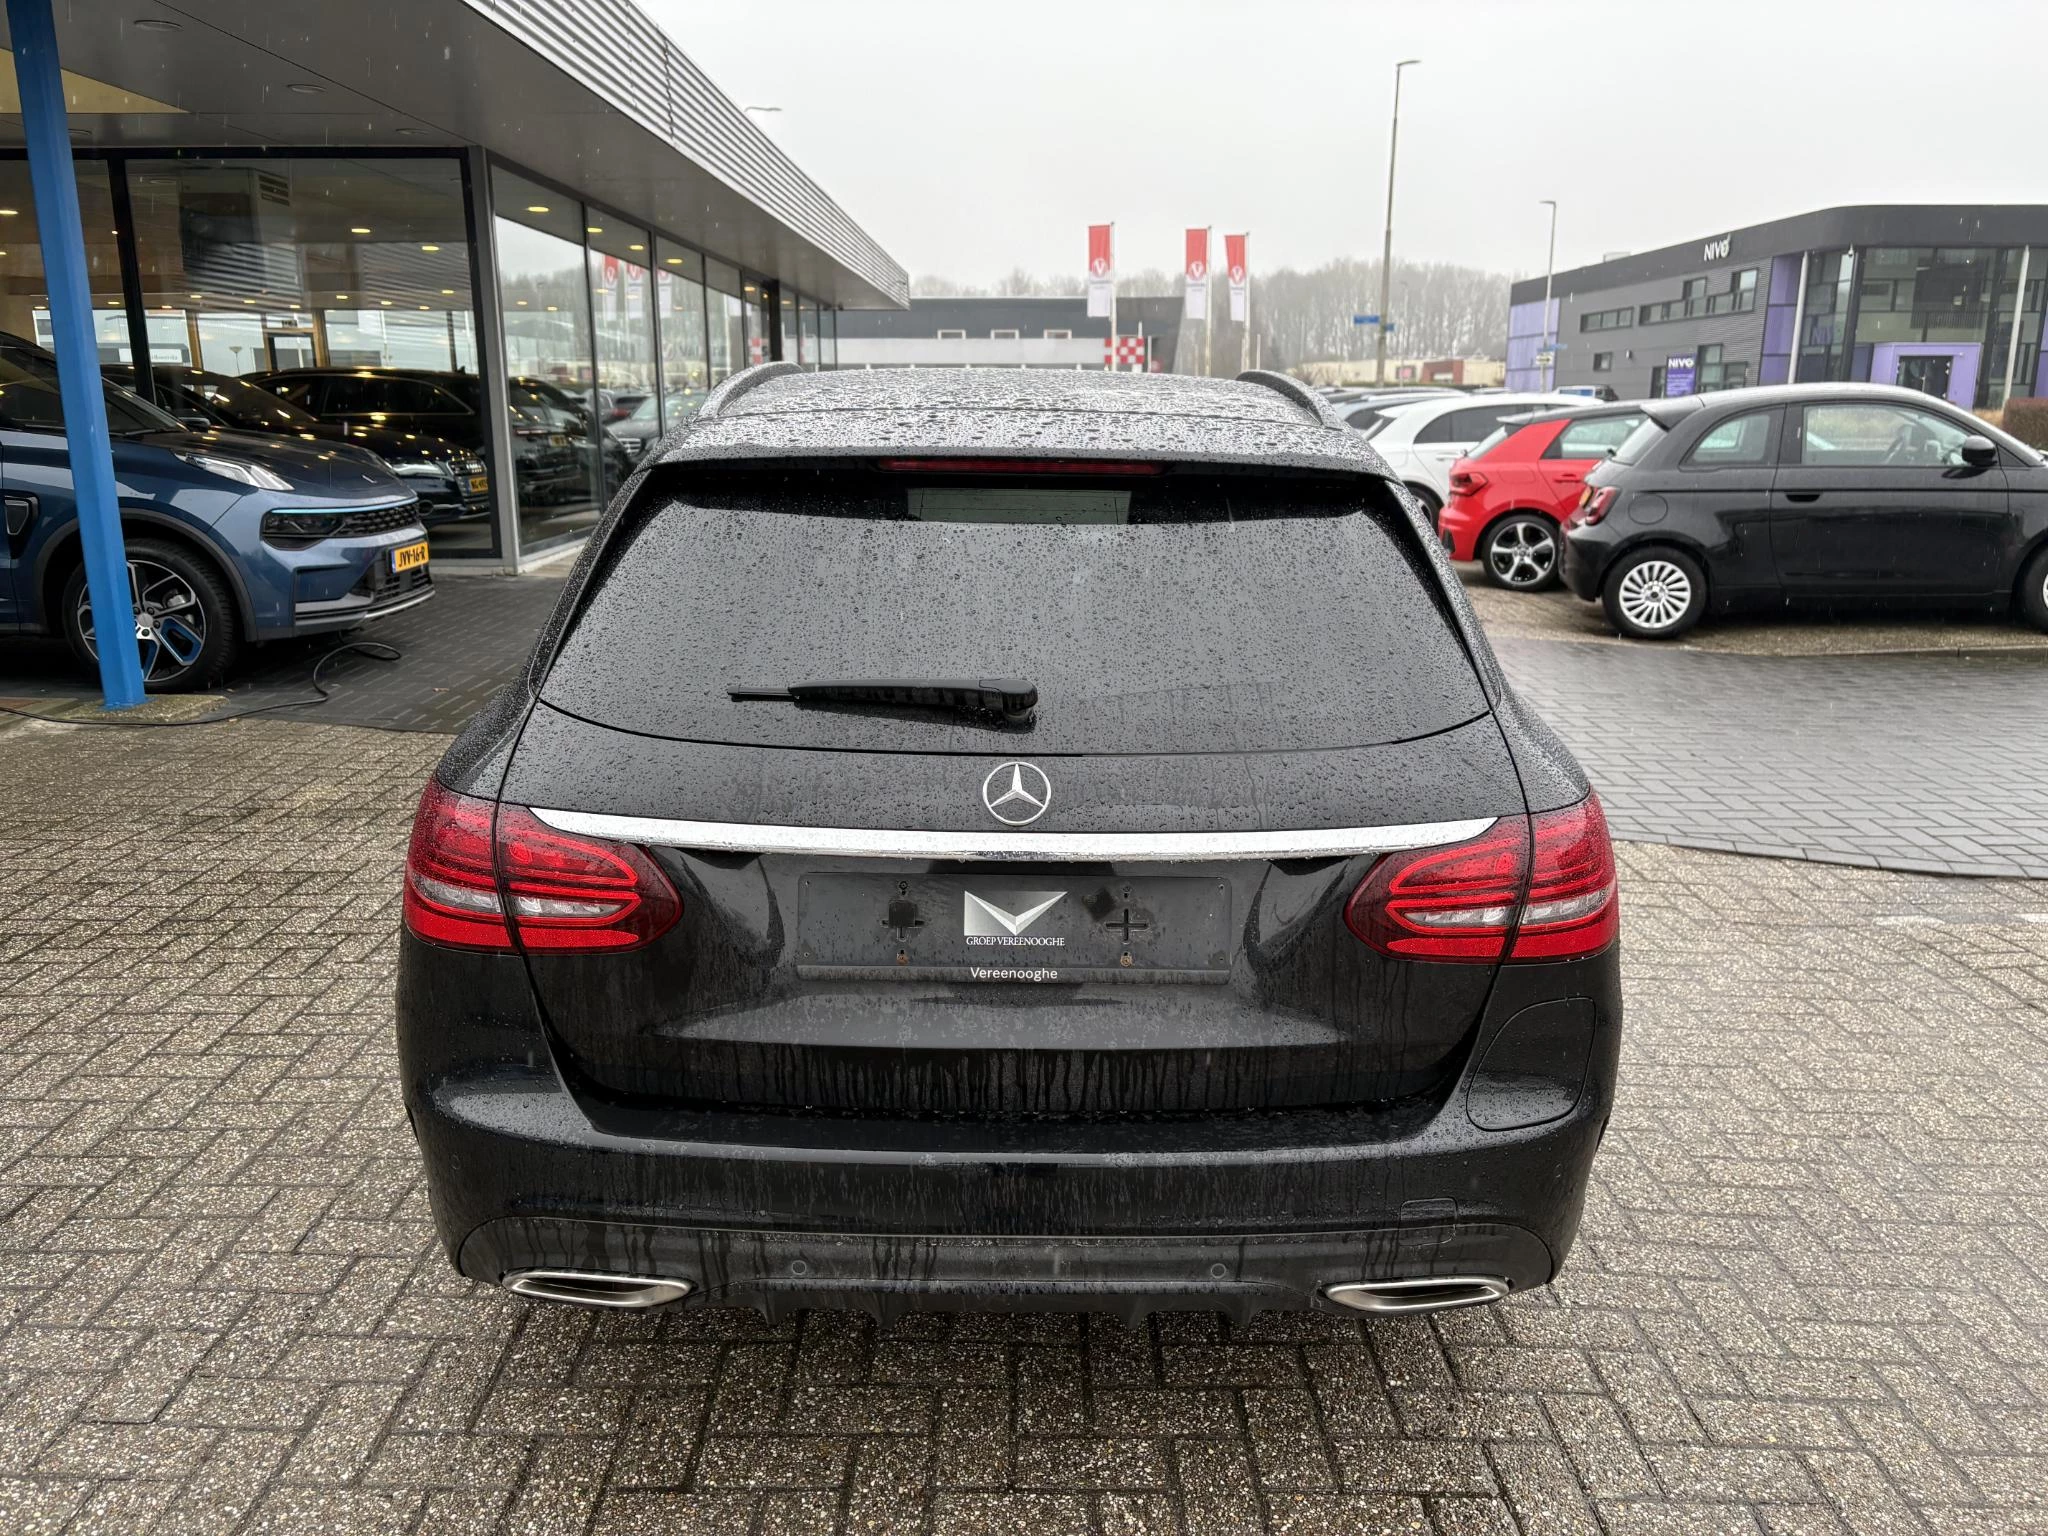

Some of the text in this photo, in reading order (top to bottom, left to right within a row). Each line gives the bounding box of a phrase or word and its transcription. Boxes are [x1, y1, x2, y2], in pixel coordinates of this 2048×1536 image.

[966, 936, 1066, 947] GROEP VEREENOOGHE
[970, 967, 1058, 982] Vereenooghe
